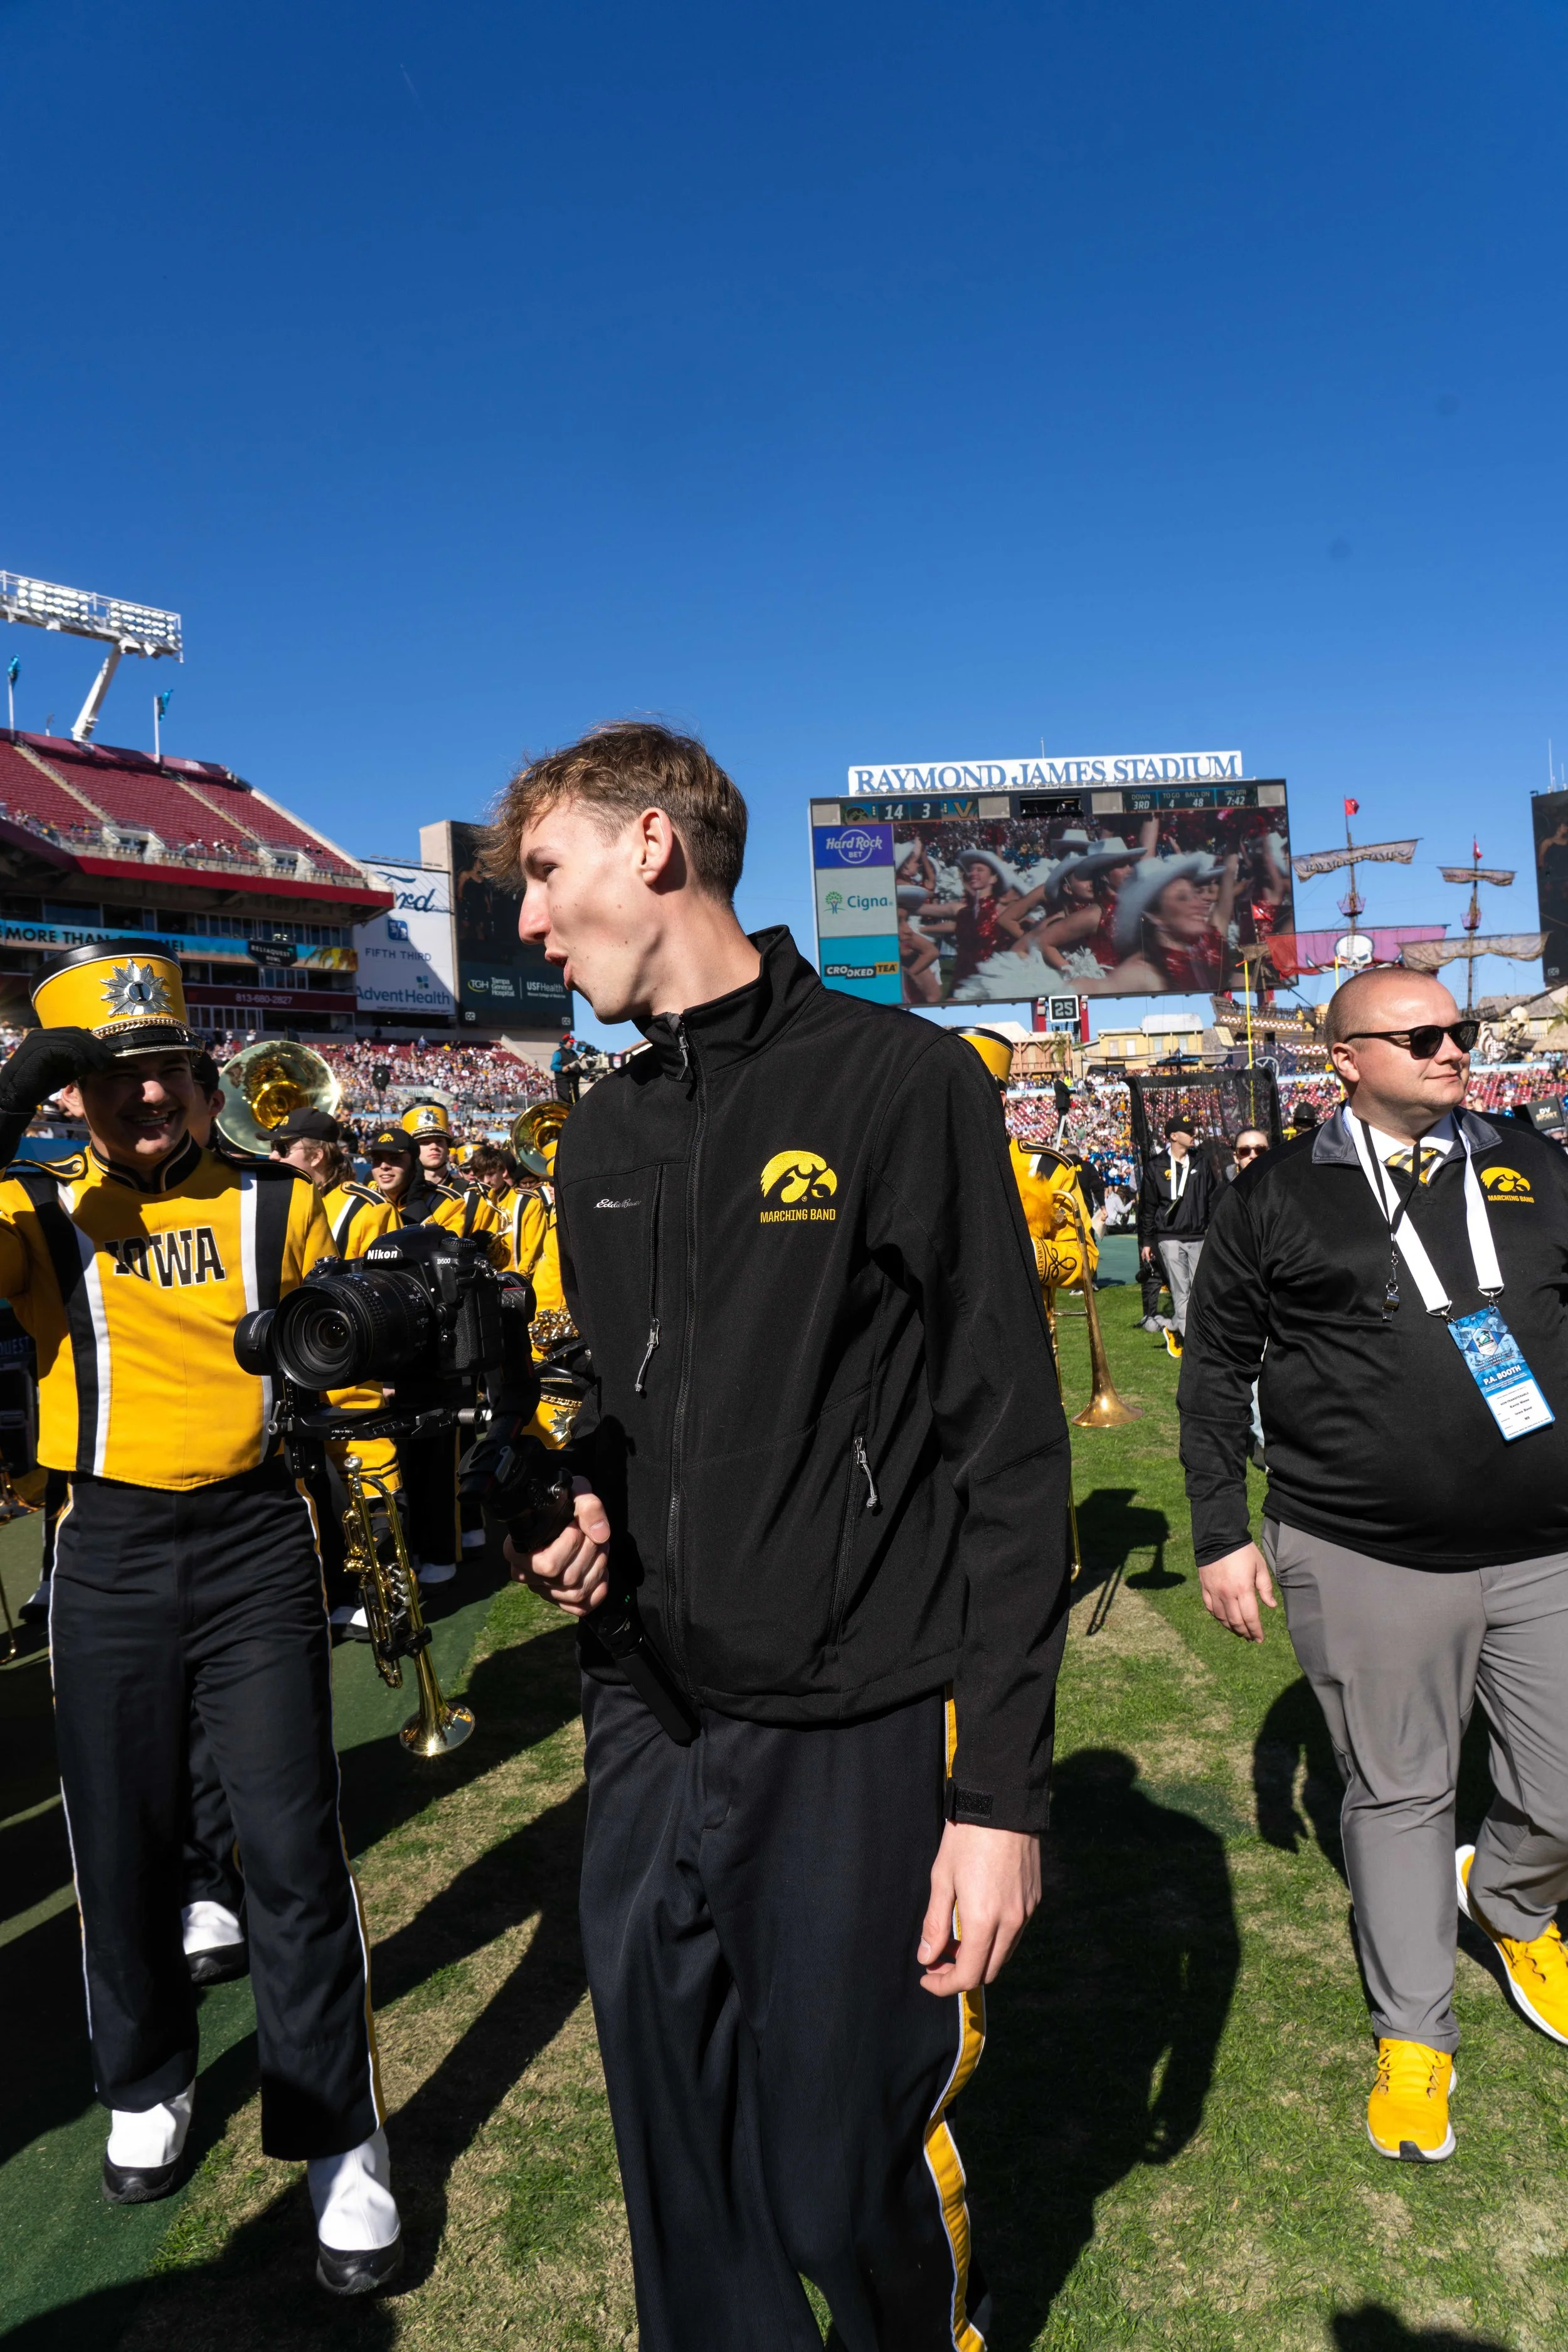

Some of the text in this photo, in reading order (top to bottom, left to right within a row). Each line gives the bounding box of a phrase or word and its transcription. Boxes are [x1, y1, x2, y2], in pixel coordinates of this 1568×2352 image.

[855, 755, 1238, 792] RAYMOND JAMES STADIUM
[1133, 800, 1150, 810] 3RD
[1169, 799, 1175, 808] 4
[1193, 798, 1204, 807] 48
[1226, 796, 1245, 805] 7:42
[885, 804, 903, 820] 14
[922, 803, 931, 818] 3
[826, 836, 882, 850] Hard Rock
[847, 895, 888, 910] Cigna
[6, 928, 56, 943] MORE
[365, 948, 432, 961] FIFTH THIRD
[827, 964, 895, 978] CROOKED TEA
[471, 980, 489, 988] TGH
[1055, 1001, 1073, 1016] 25
[593, 1199, 642, 1209] Eddie Bauer
[760, 1209, 836, 1223] MARCHING BAND
[105, 1226, 226, 1288] IOWA
[367, 1249, 398, 1260] Nikon
[1483, 1376, 1497, 1385] P.A.
[1496, 1365, 1522, 1380] BOOTH
